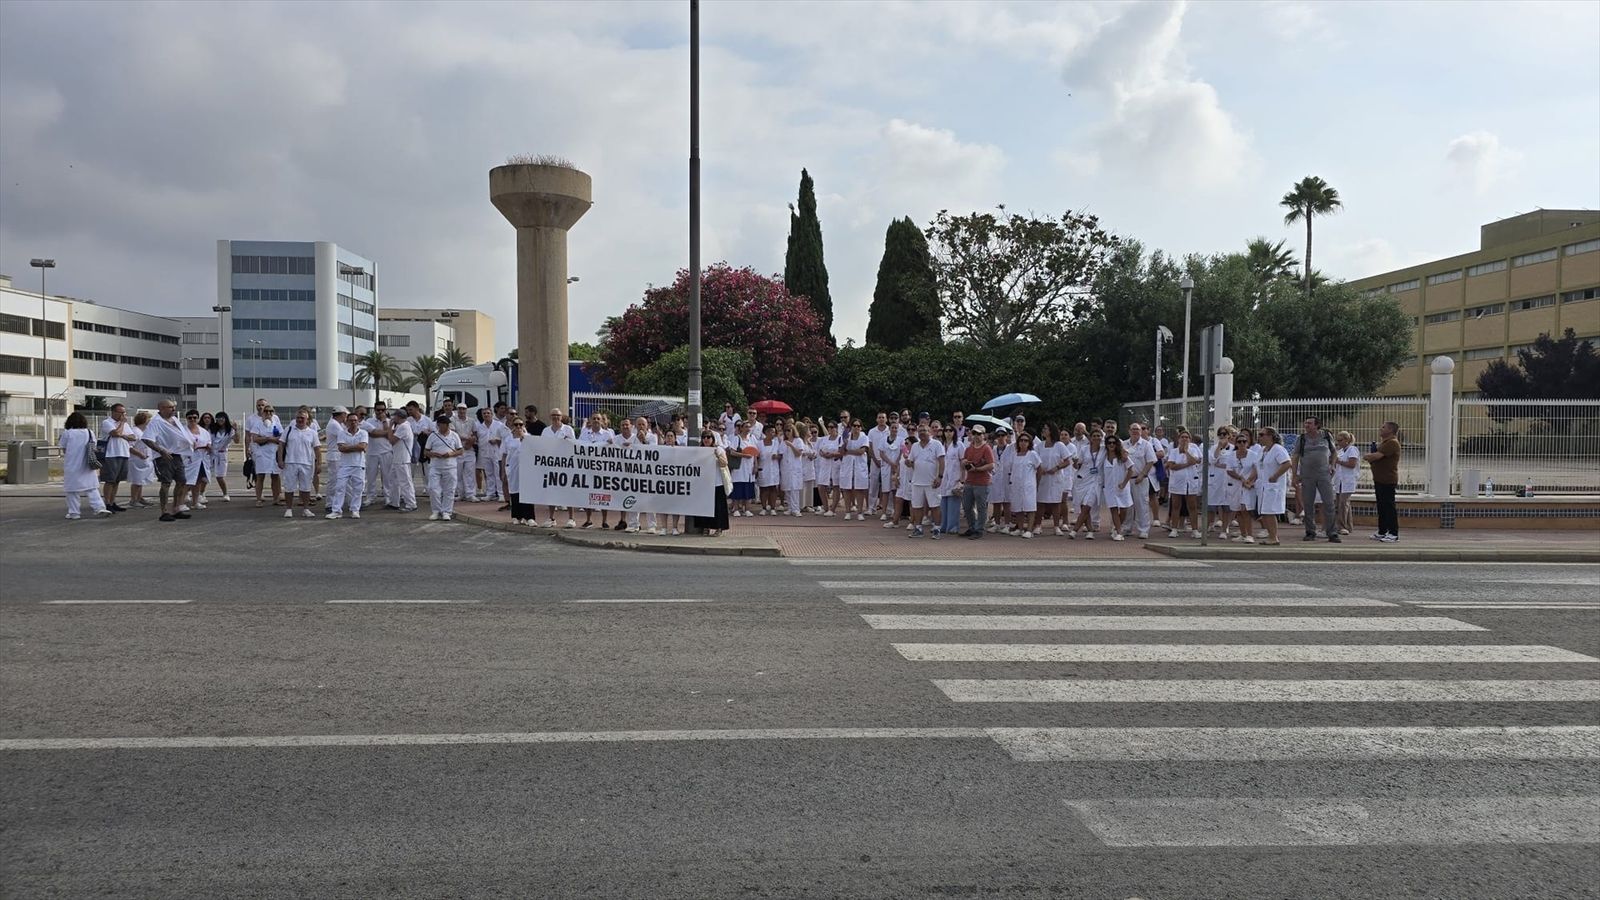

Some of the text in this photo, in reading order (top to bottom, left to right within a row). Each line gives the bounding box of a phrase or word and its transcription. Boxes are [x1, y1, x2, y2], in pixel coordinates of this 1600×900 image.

[574, 444, 660, 461] LA PLANTILLA NO
[534, 455, 701, 477] PAGARÁ VUESTRA MALA GESTIÓN
[543, 472, 691, 495] ¡NO AL DESCUELGUE!
